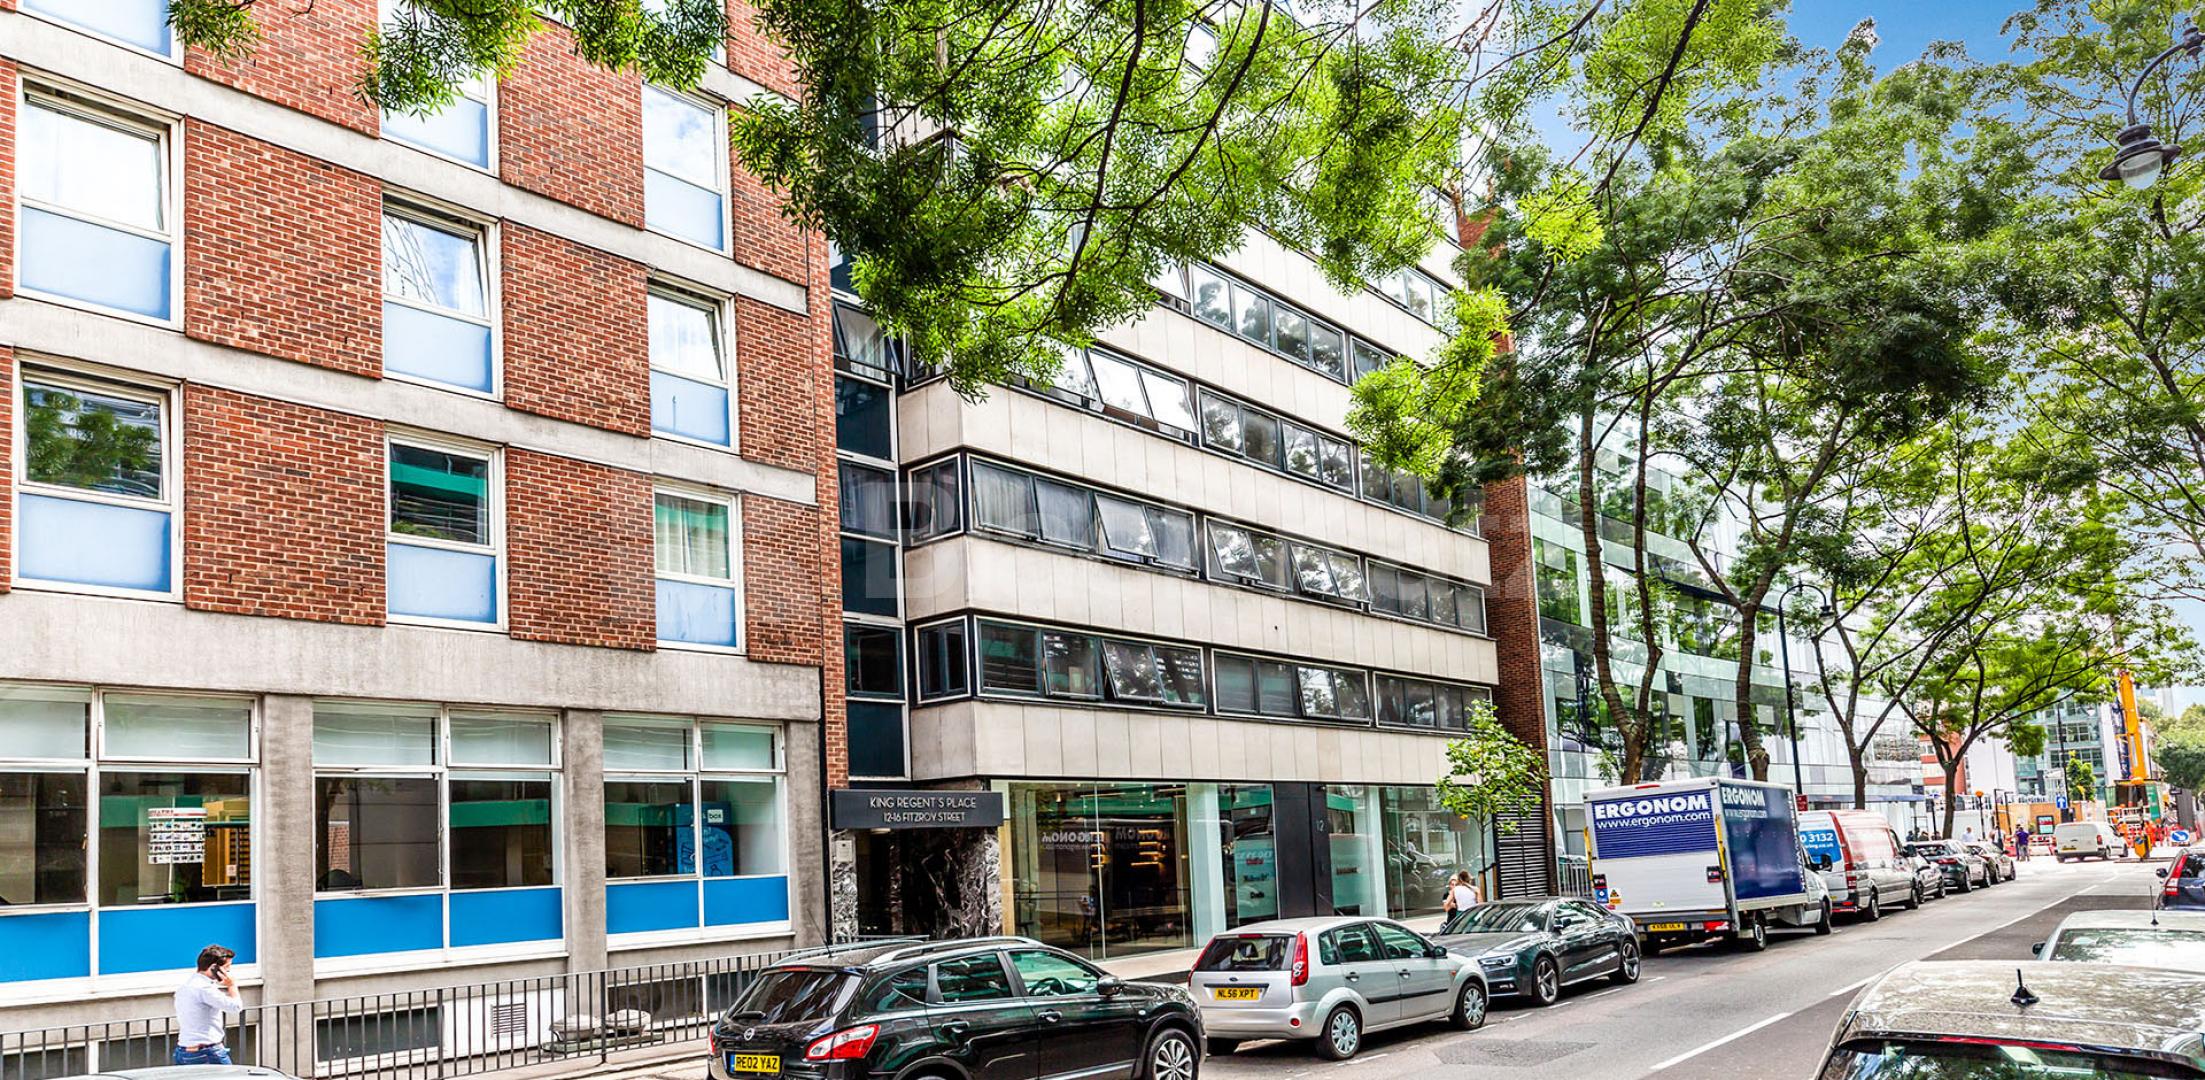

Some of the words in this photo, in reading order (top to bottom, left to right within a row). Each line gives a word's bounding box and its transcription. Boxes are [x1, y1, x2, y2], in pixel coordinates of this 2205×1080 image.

[870, 796, 894, 809] KING
[946, 796, 977, 809] PLACE
[1721, 787, 1766, 806] ERGONOM
[1594, 794, 1710, 820] ERGONOM
[883, 811, 902, 823] 12-16
[902, 811, 936, 823] FITZROY
[937, 811, 966, 823] STREET
[1596, 810, 1712, 829] www.ergonom.com
[1808, 832, 1834, 842] 3132
[1239, 989, 1255, 998] XPT
[760, 1057, 778, 1070] YAZ
